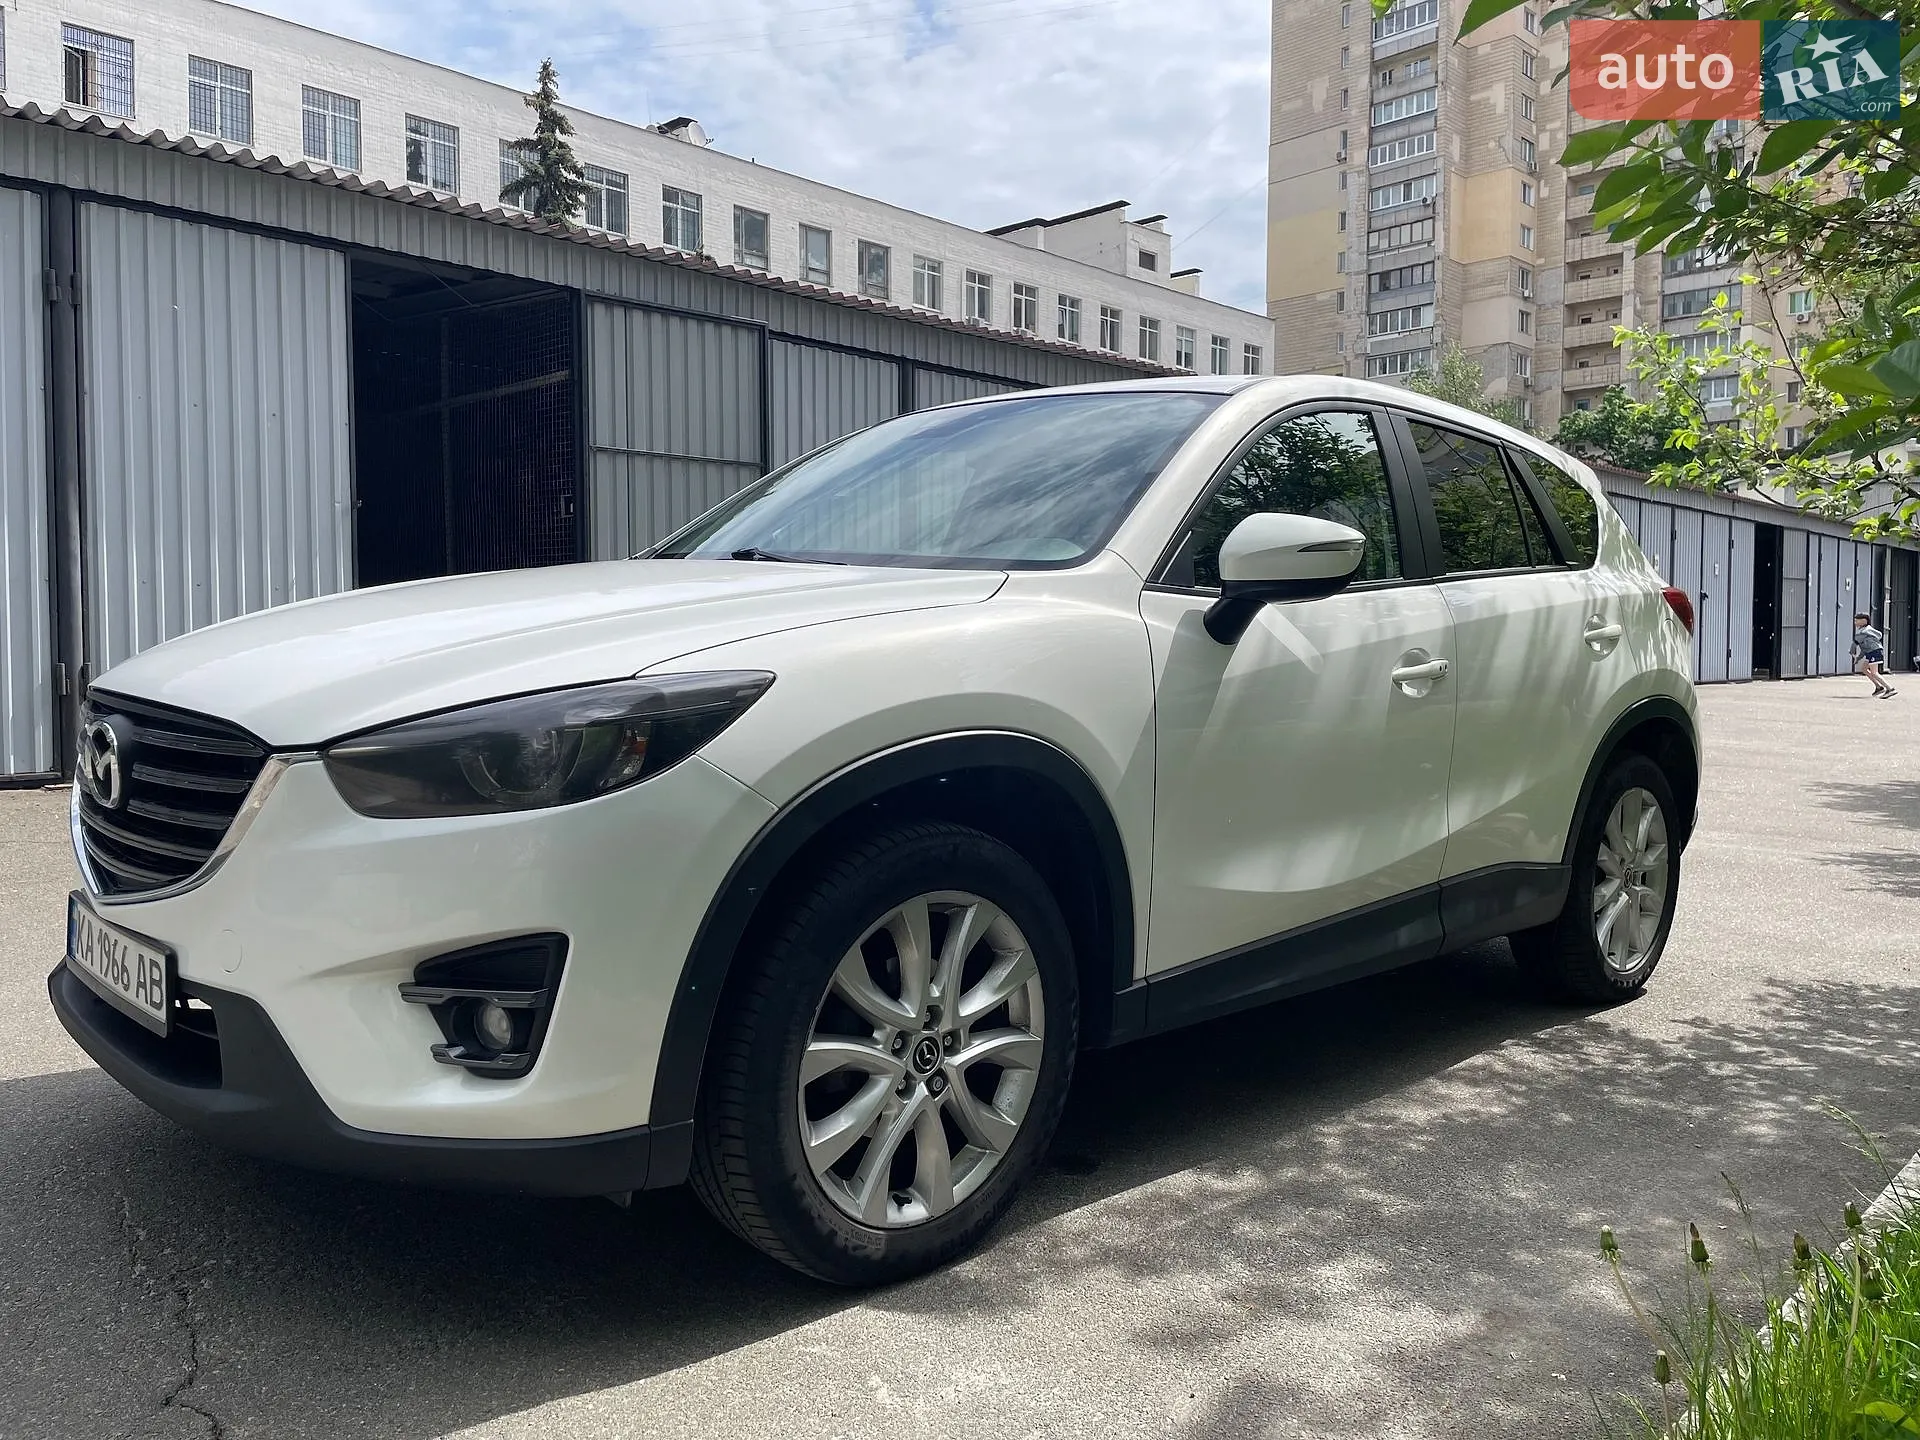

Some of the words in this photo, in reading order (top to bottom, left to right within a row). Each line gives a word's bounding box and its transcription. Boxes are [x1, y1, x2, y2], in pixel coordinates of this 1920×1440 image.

[77, 910, 94, 966] KA
[97, 928, 130, 991] 1966
[136, 953, 164, 1011] AB
